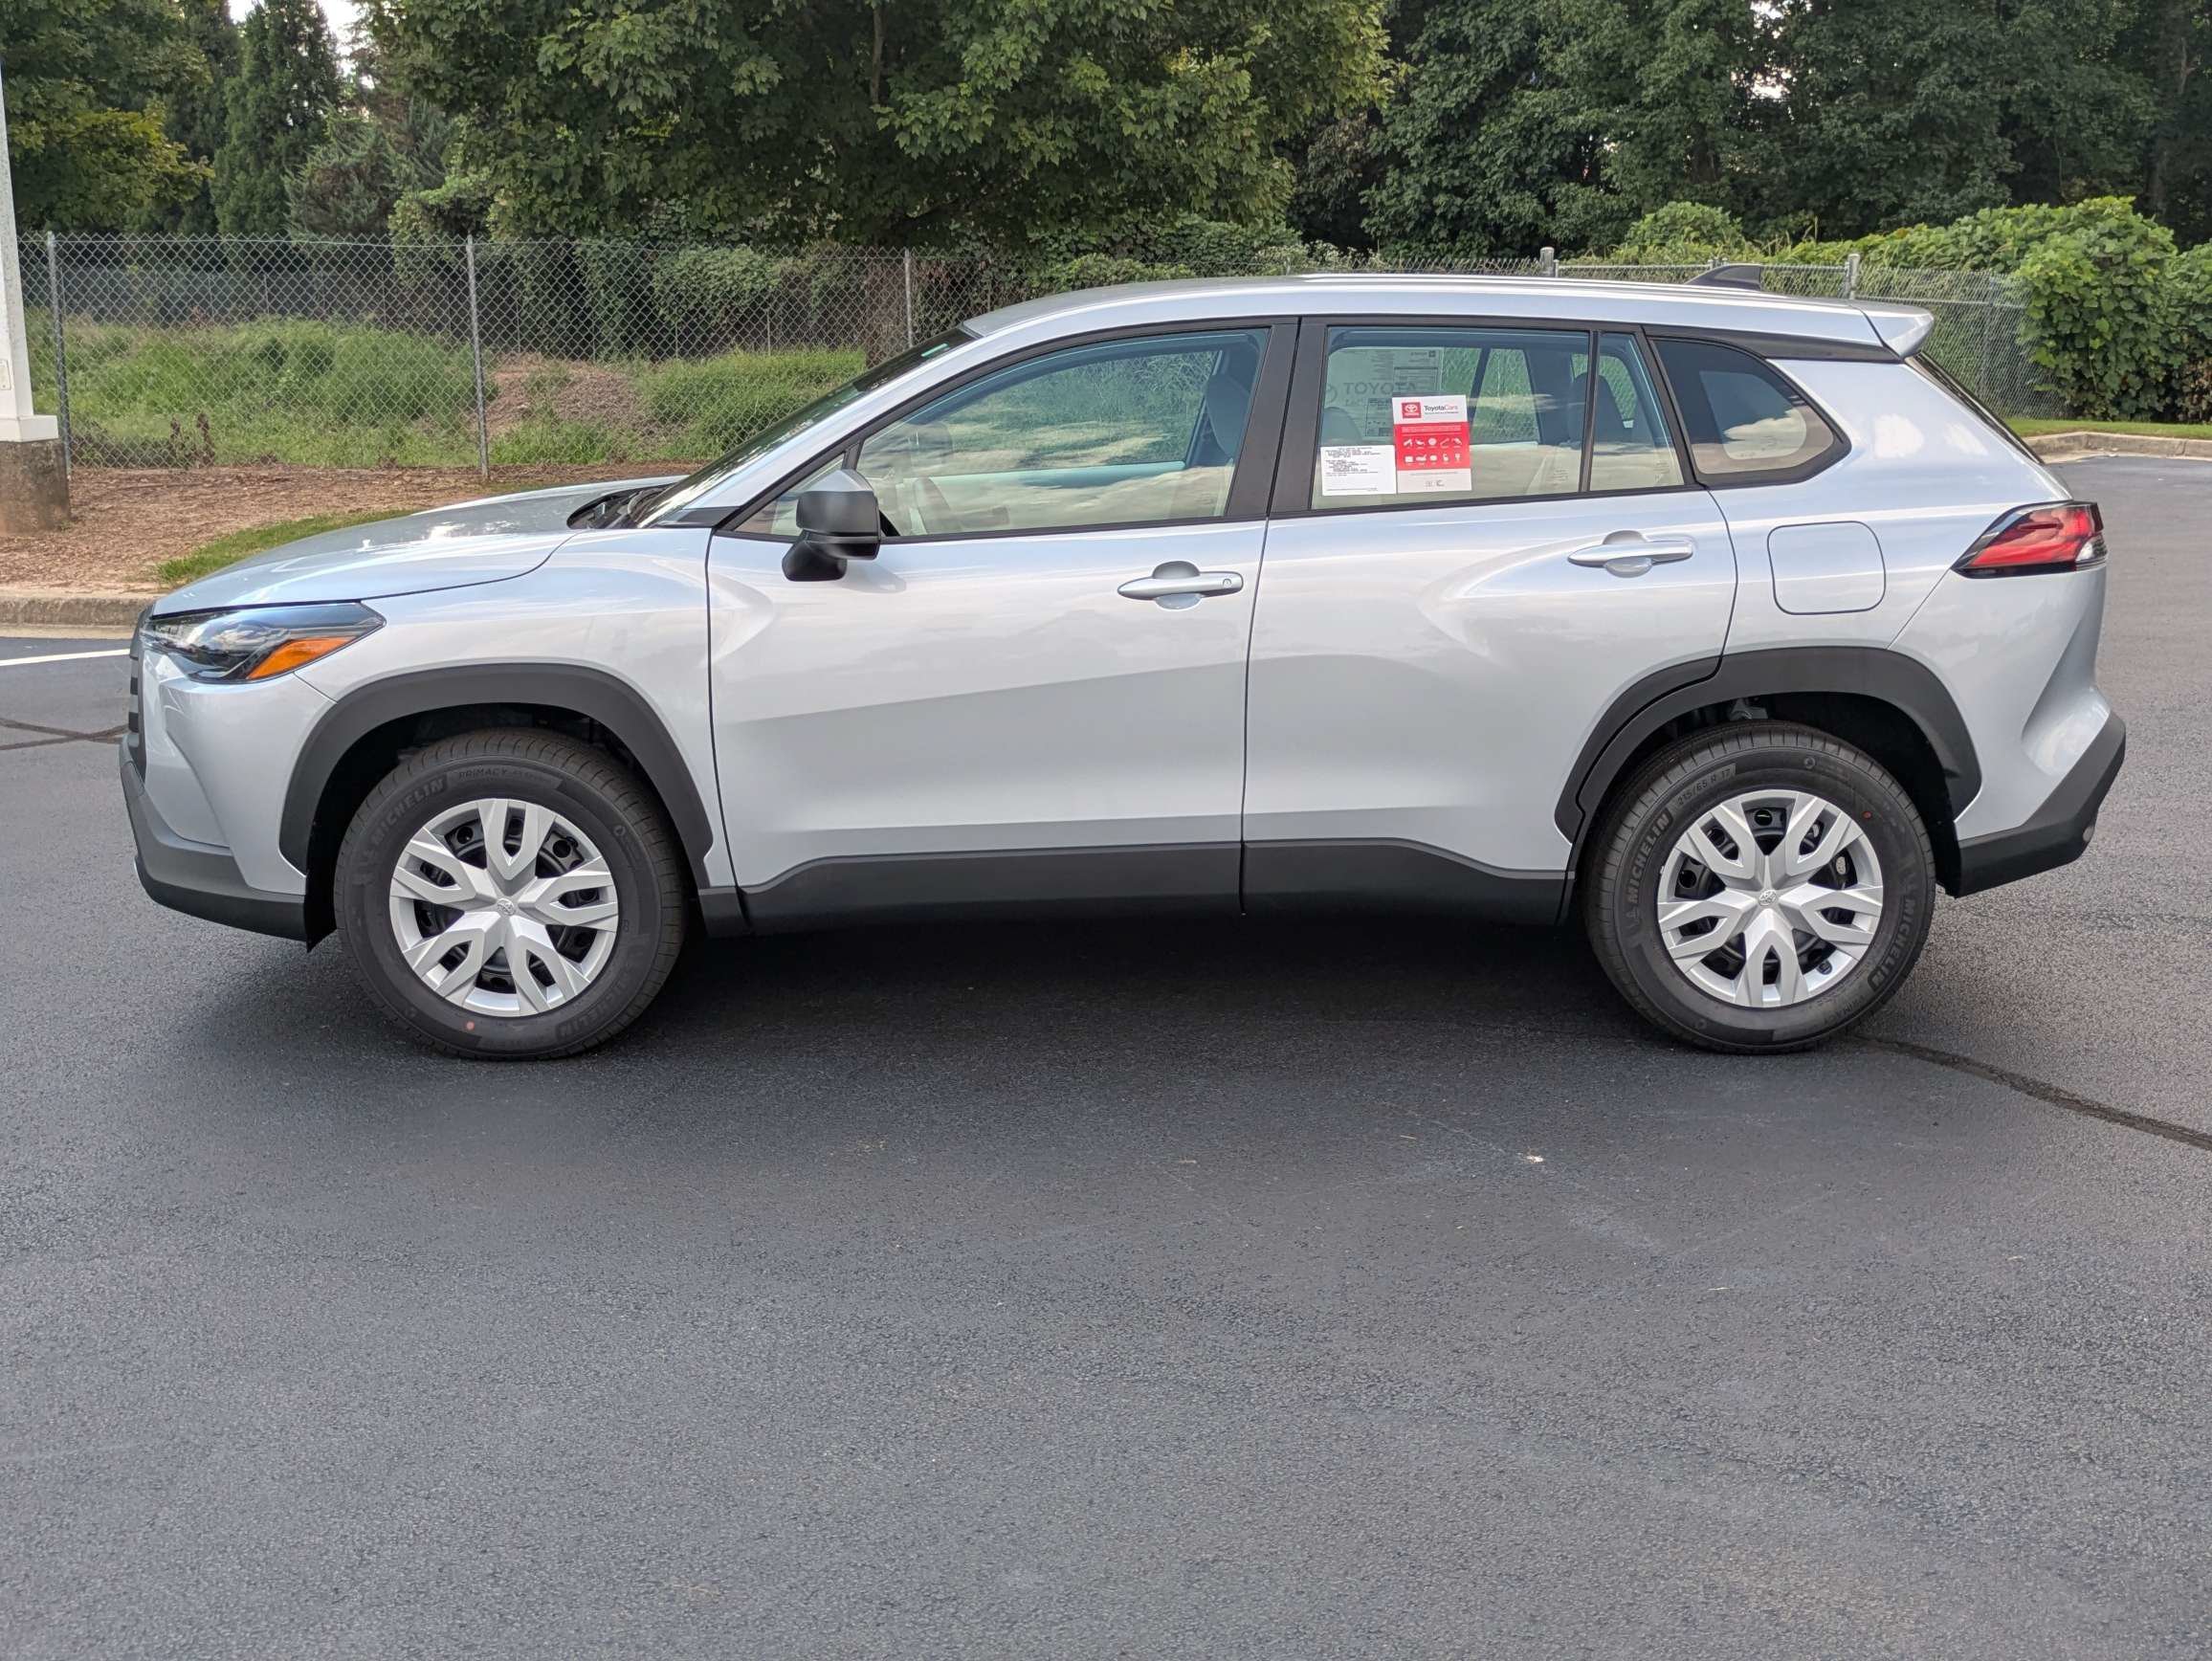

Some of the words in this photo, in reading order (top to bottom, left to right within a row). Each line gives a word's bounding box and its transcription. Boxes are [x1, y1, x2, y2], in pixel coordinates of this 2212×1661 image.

[373, 779, 445, 843] MICHELIN
[1628, 813, 1670, 903] MICHELIN
[1872, 898, 1915, 986] MICHELIN
